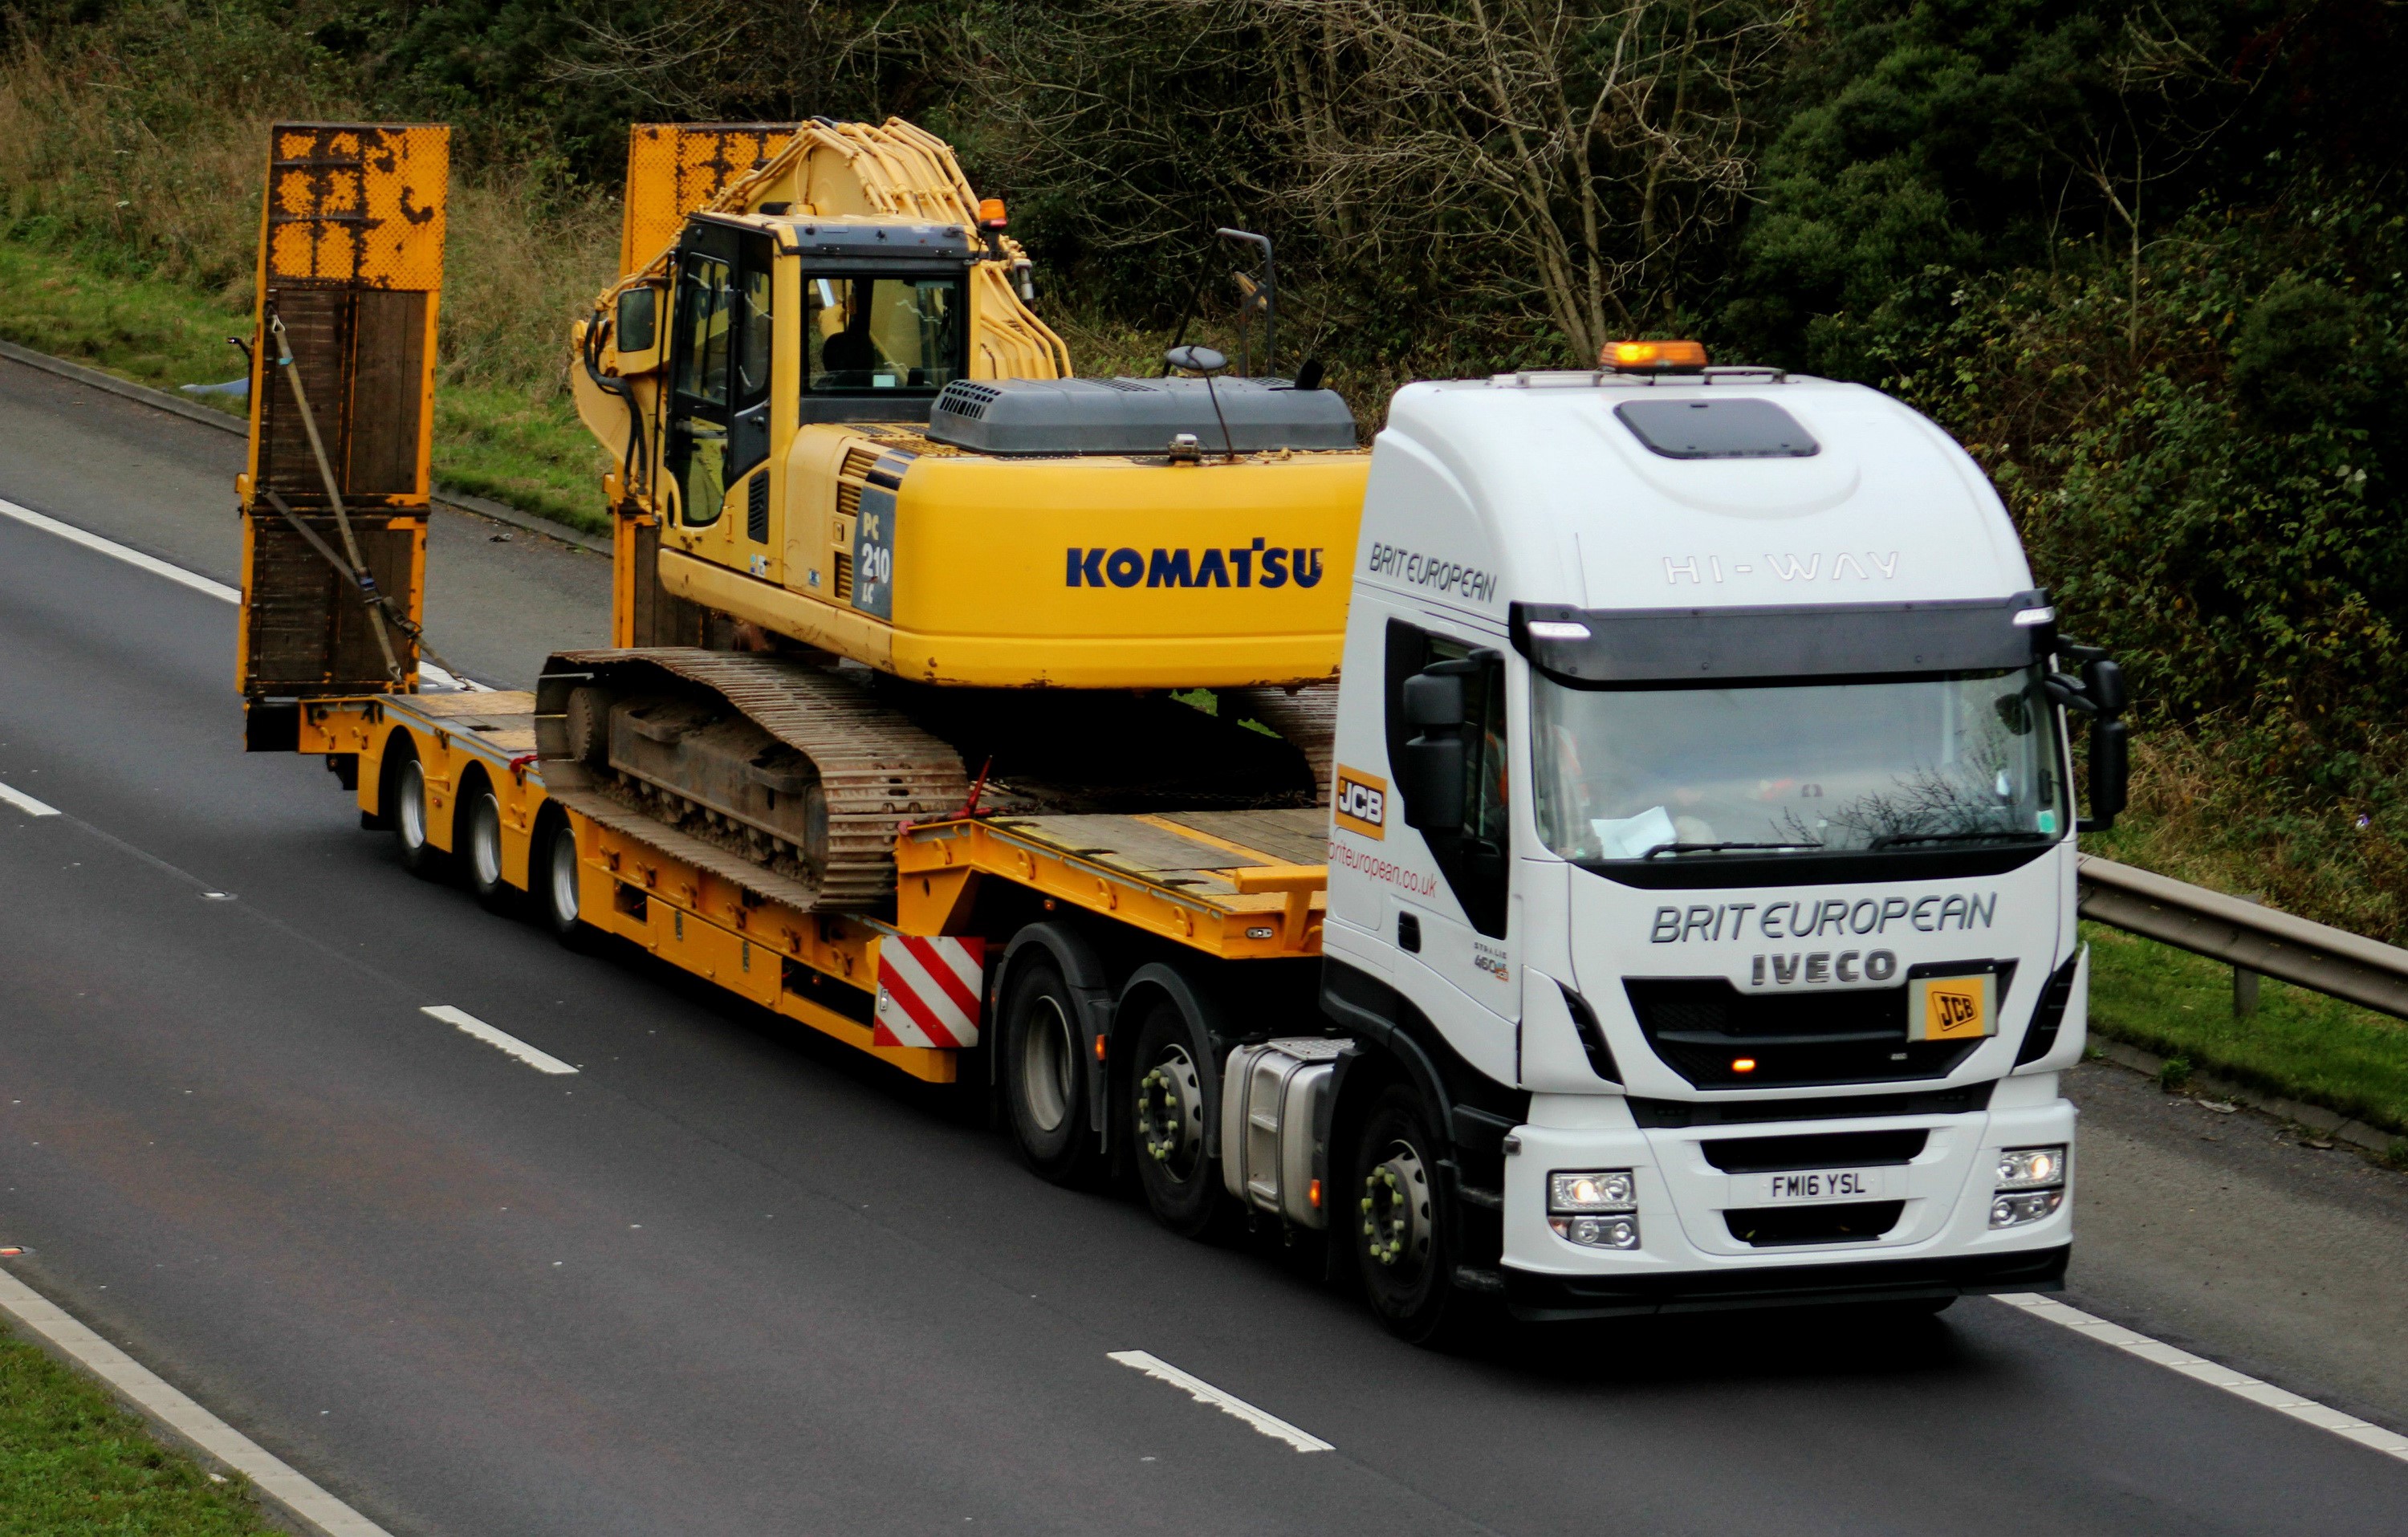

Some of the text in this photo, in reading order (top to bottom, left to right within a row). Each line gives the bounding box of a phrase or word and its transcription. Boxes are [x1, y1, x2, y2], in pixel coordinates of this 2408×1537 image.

[863, 511, 879, 541] PC
[862, 543, 890, 583] 210
[1066, 537, 1324, 588] KOMATSU
[1369, 542, 1497, 604] BRIT EUROPEAN
[1338, 781, 1383, 823] JCB
[1649, 892, 1998, 943] BRIT EUROPEAN
[1751, 949, 1898, 986] IVECO
[1940, 995, 1975, 1027] JCB
[1772, 1173, 1866, 1197] FM16 YSL
